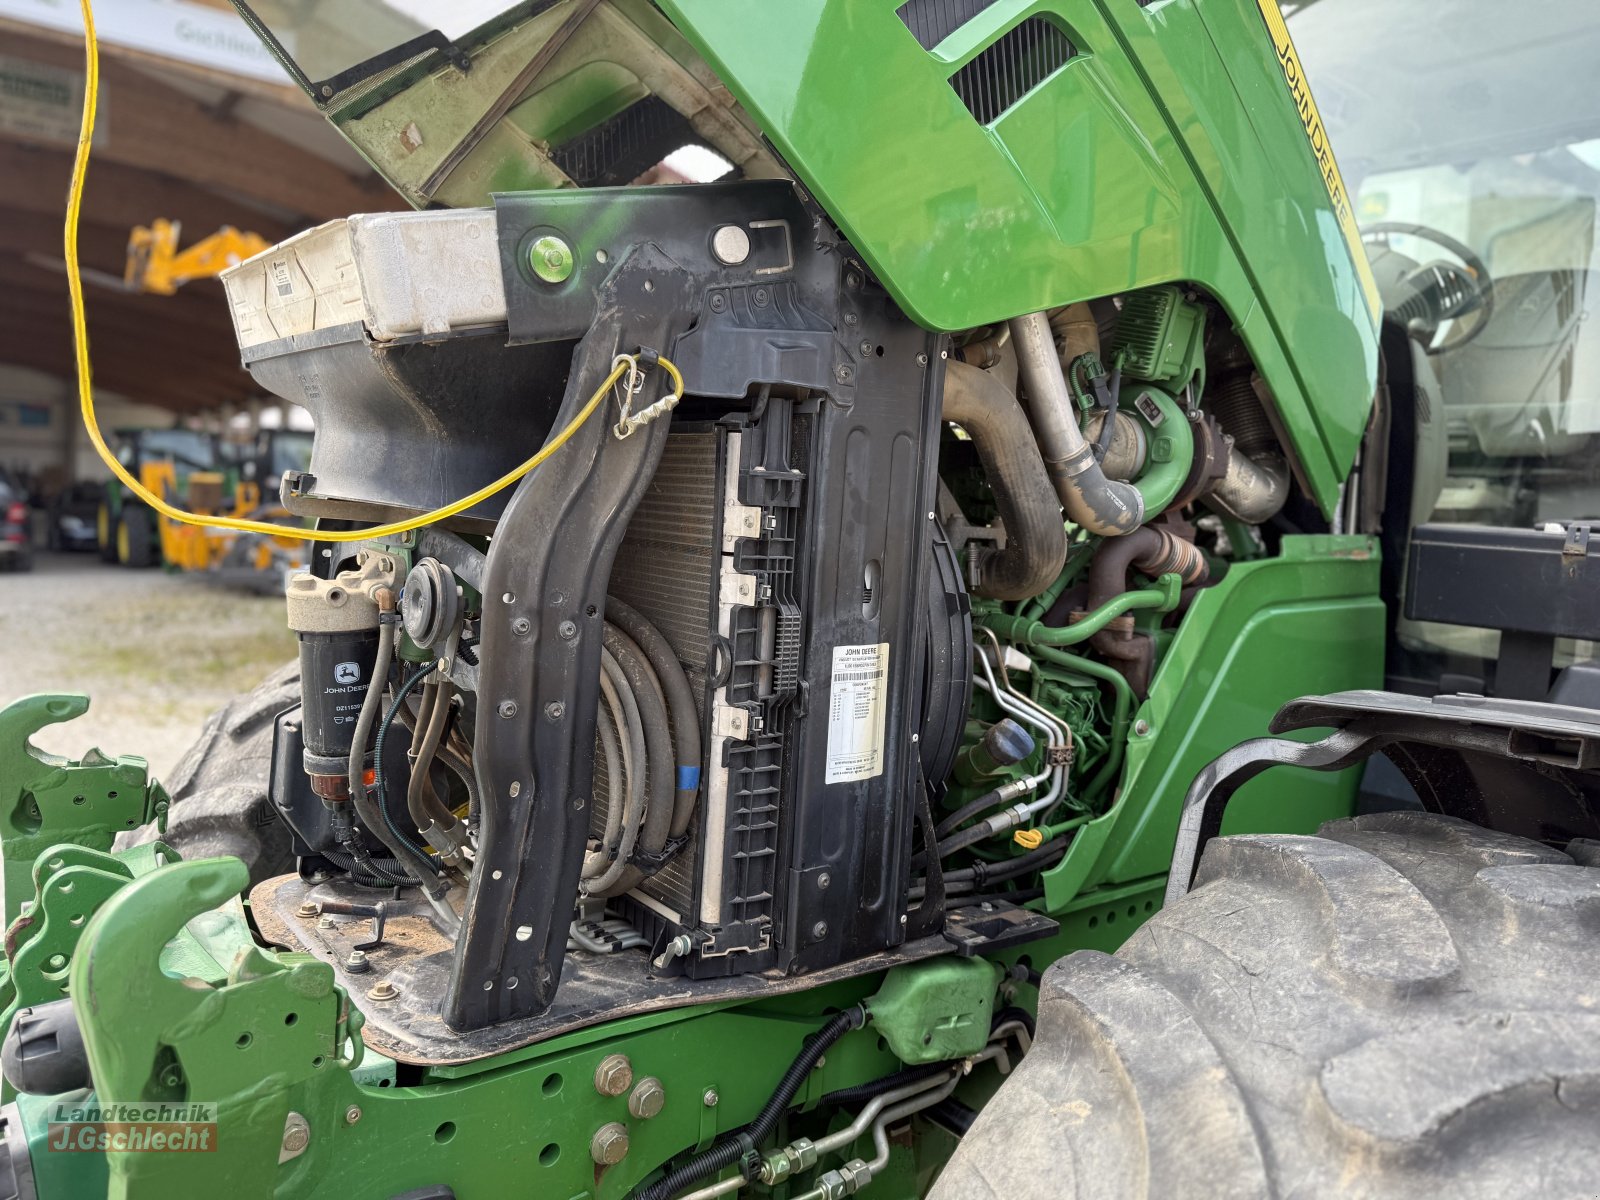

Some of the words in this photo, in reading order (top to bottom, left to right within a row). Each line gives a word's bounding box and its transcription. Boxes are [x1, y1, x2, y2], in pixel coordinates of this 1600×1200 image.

[1277, 43, 1313, 129] JOHN
[1311, 122, 1348, 226] DEERE
[845, 648, 861, 656] JOHN
[861, 647, 877, 655] DEERE
